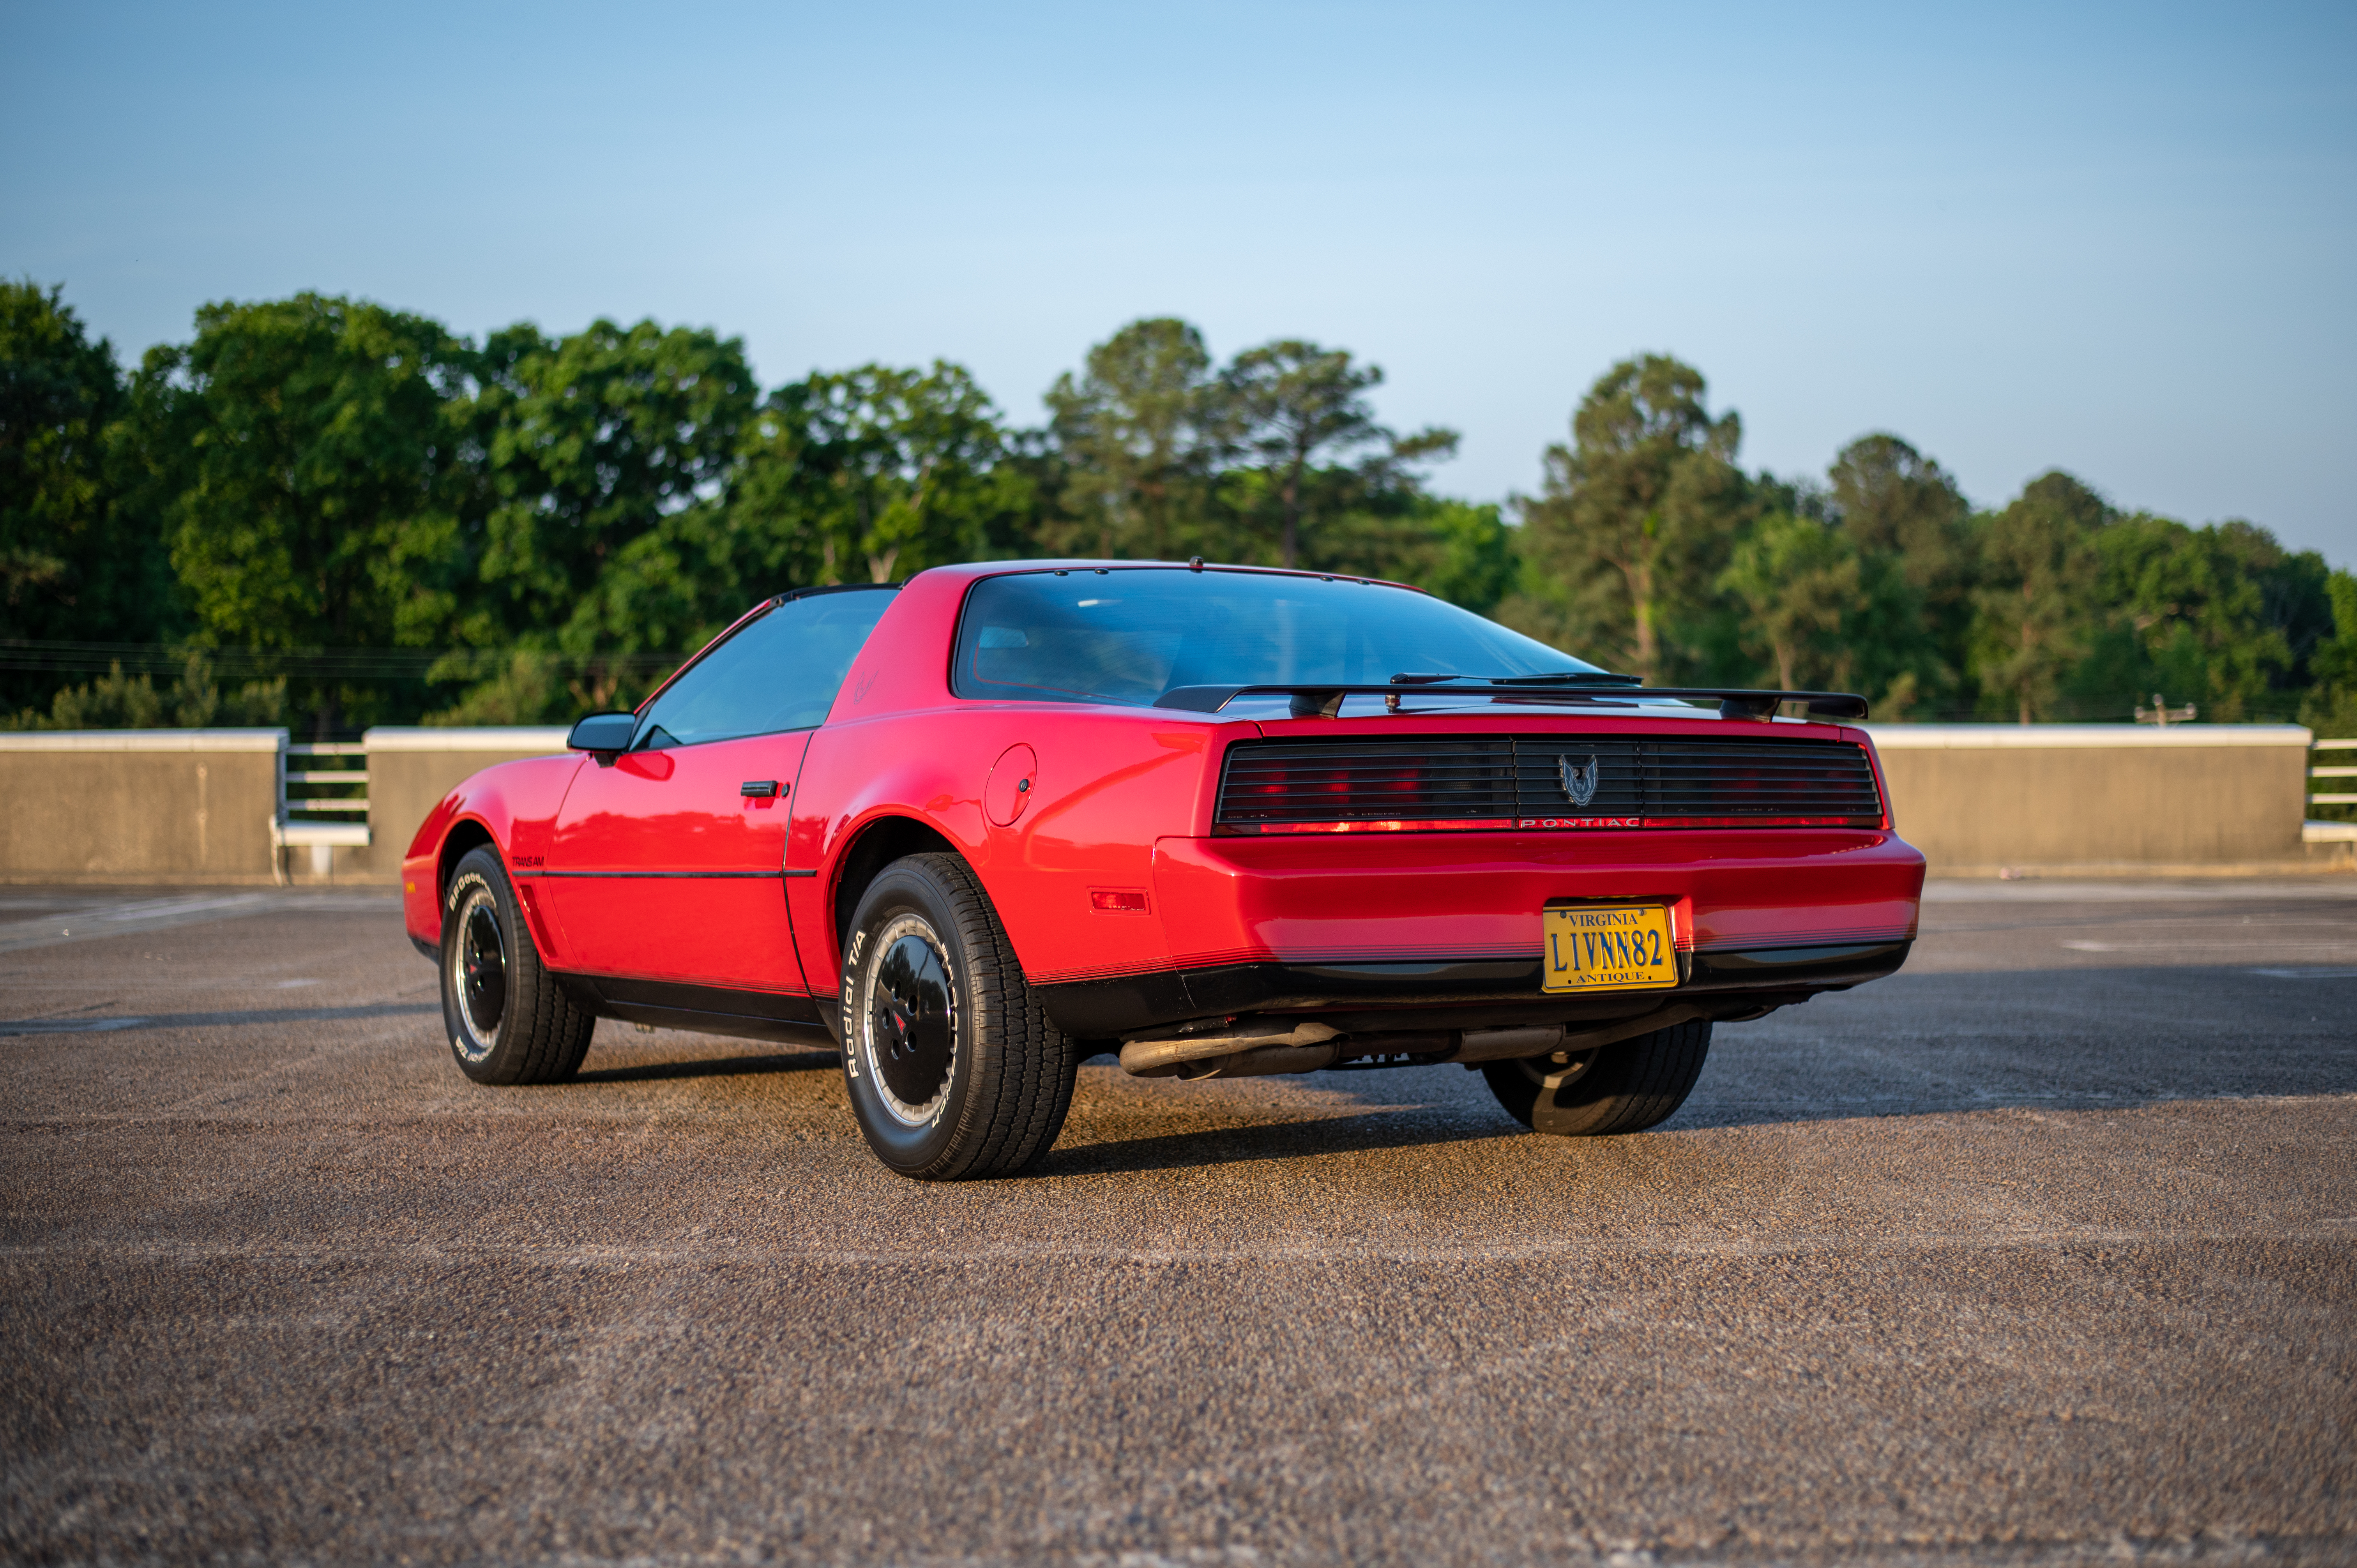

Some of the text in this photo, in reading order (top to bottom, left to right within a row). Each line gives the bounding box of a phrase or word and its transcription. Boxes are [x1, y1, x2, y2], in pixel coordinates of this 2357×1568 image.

[1521, 818, 1639, 828] PONTIAC
[512, 856, 544, 867] TRANS AM
[449, 872, 497, 912] BFGoodr
[1568, 913, 1638, 927] VIRGINIA
[849, 930, 866, 966] T/A
[1576, 971, 1645, 983] ANTIQUE
[843, 976, 859, 1078] Radial
